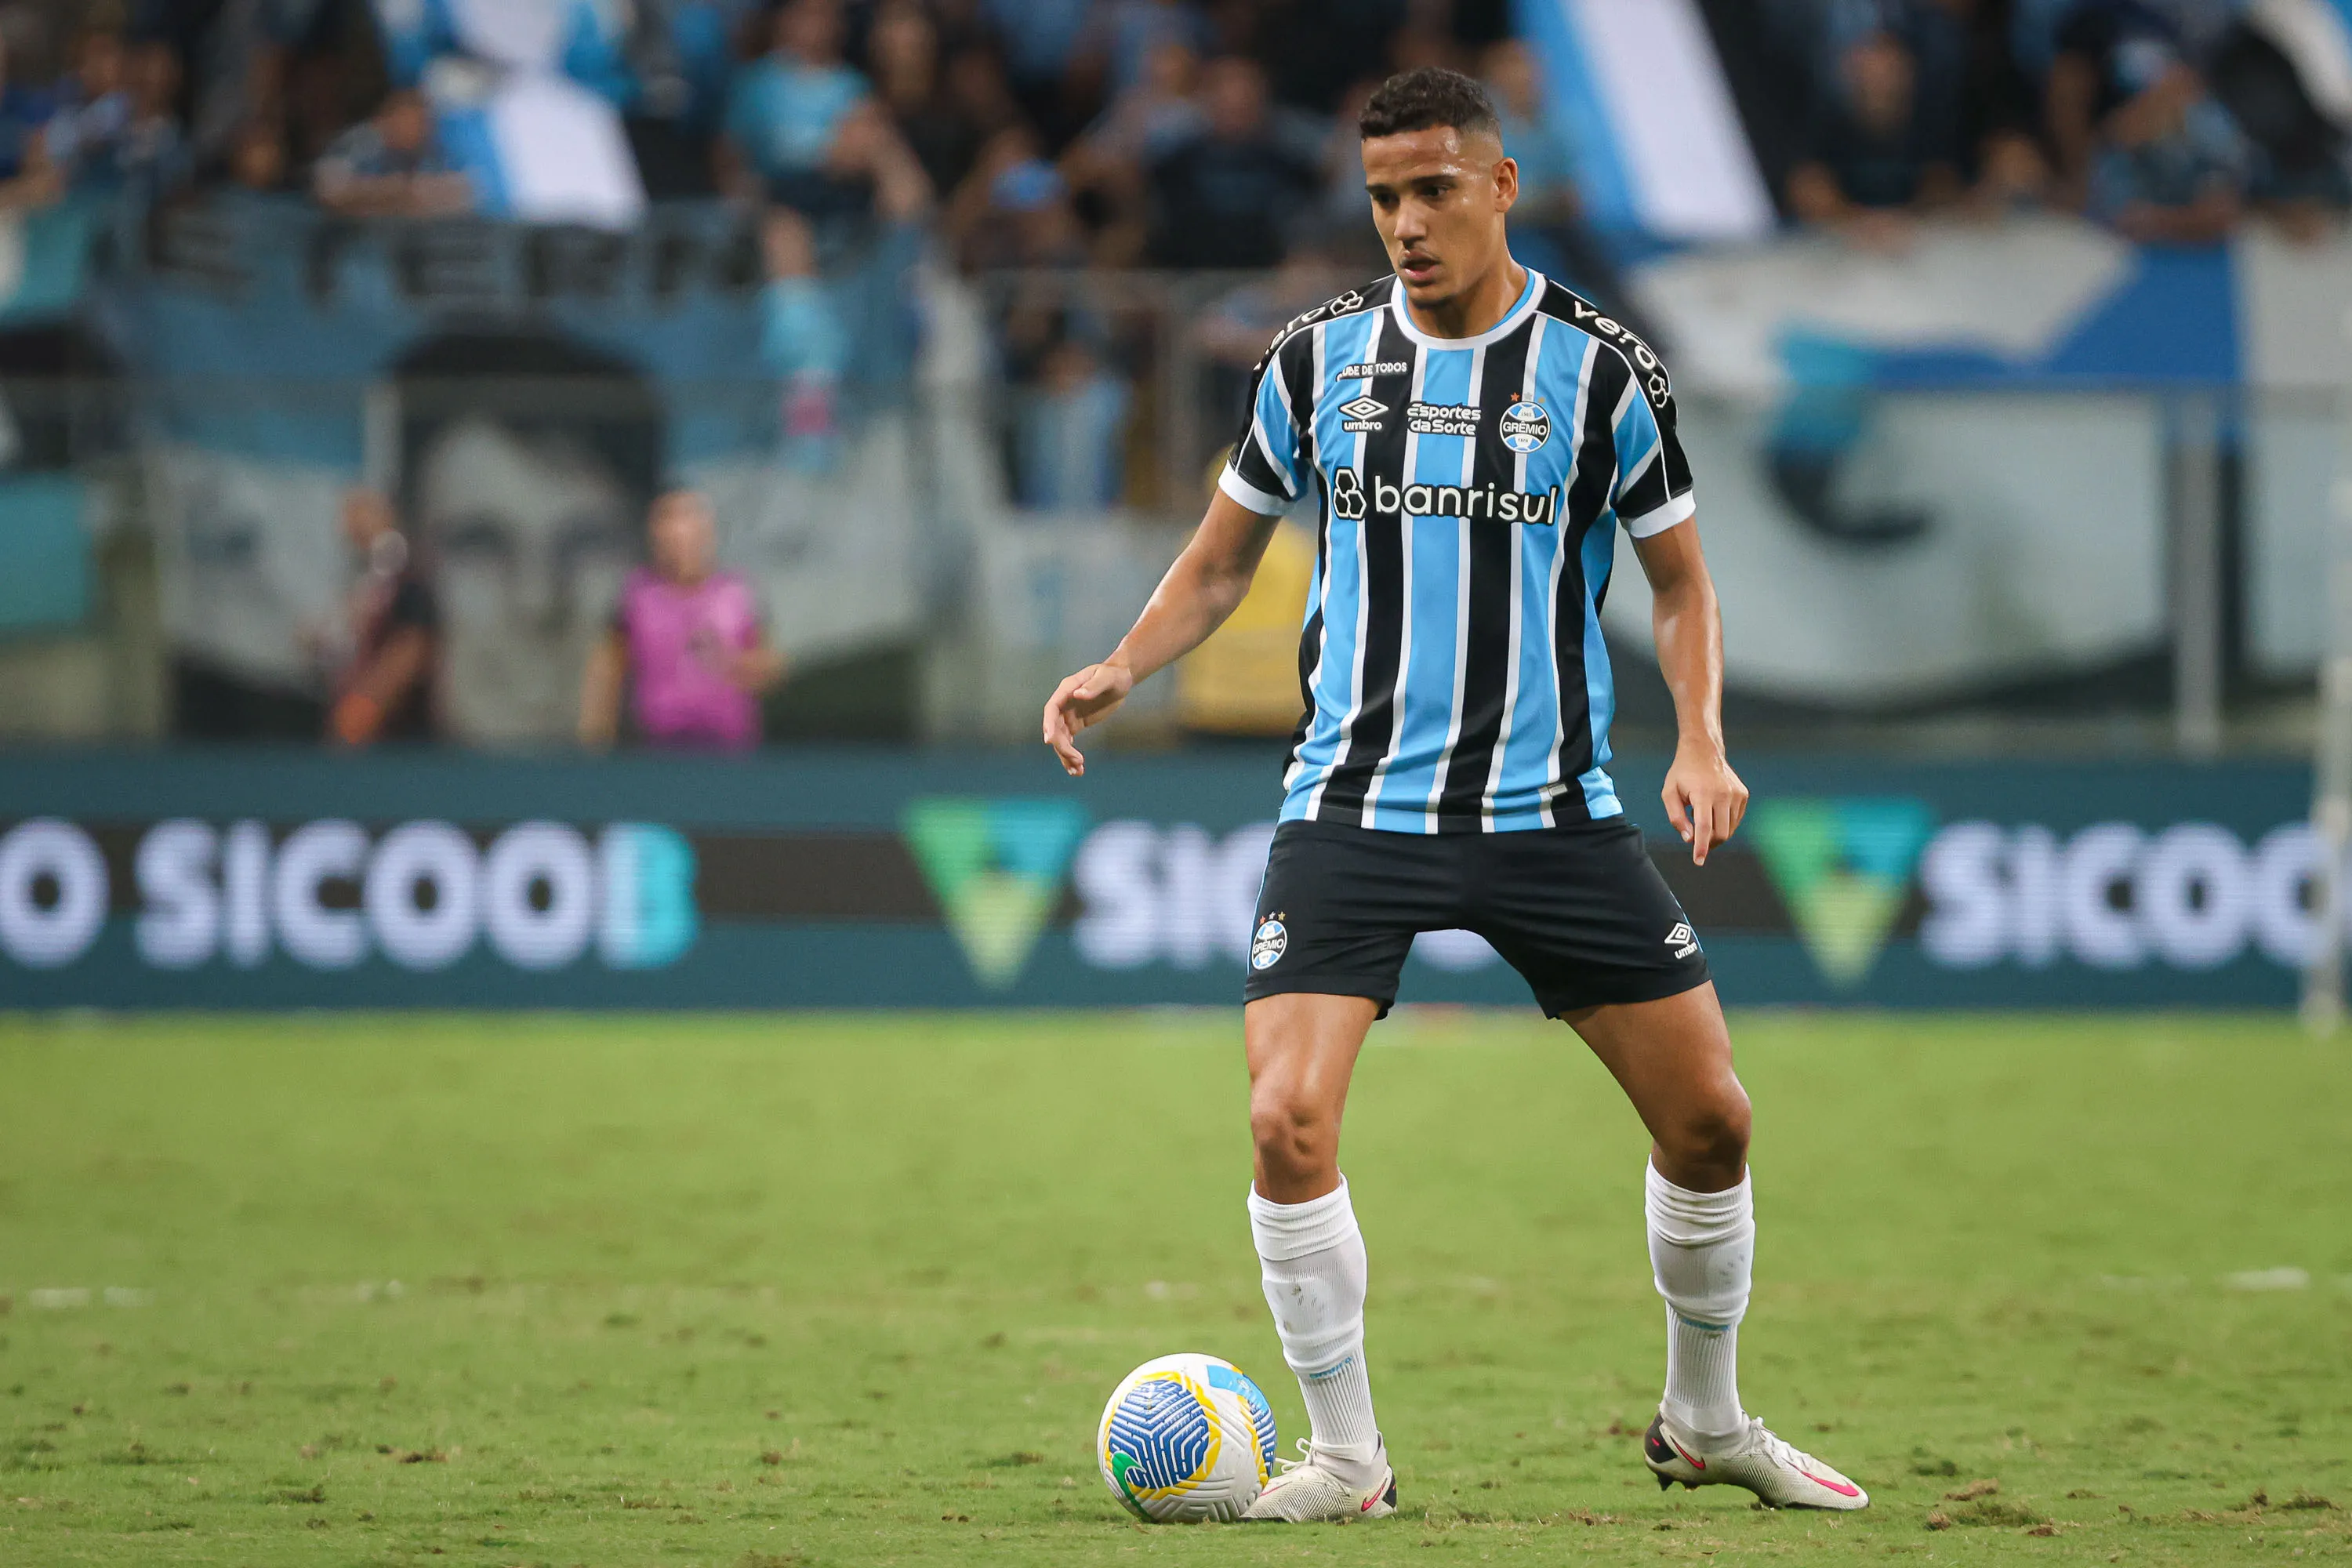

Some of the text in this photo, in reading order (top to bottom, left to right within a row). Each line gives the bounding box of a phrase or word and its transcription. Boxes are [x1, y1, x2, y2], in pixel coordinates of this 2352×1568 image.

[1574, 300, 1656, 370] vero
[1361, 365, 1374, 376] DE
[1375, 361, 1407, 374] TODOS
[1406, 403, 1482, 421] Esportes
[1344, 419, 1383, 430] umbro
[1502, 420, 1548, 436] GRÊMIO
[1375, 475, 1557, 524] banrisul
[133, 818, 699, 969] SICOOB
